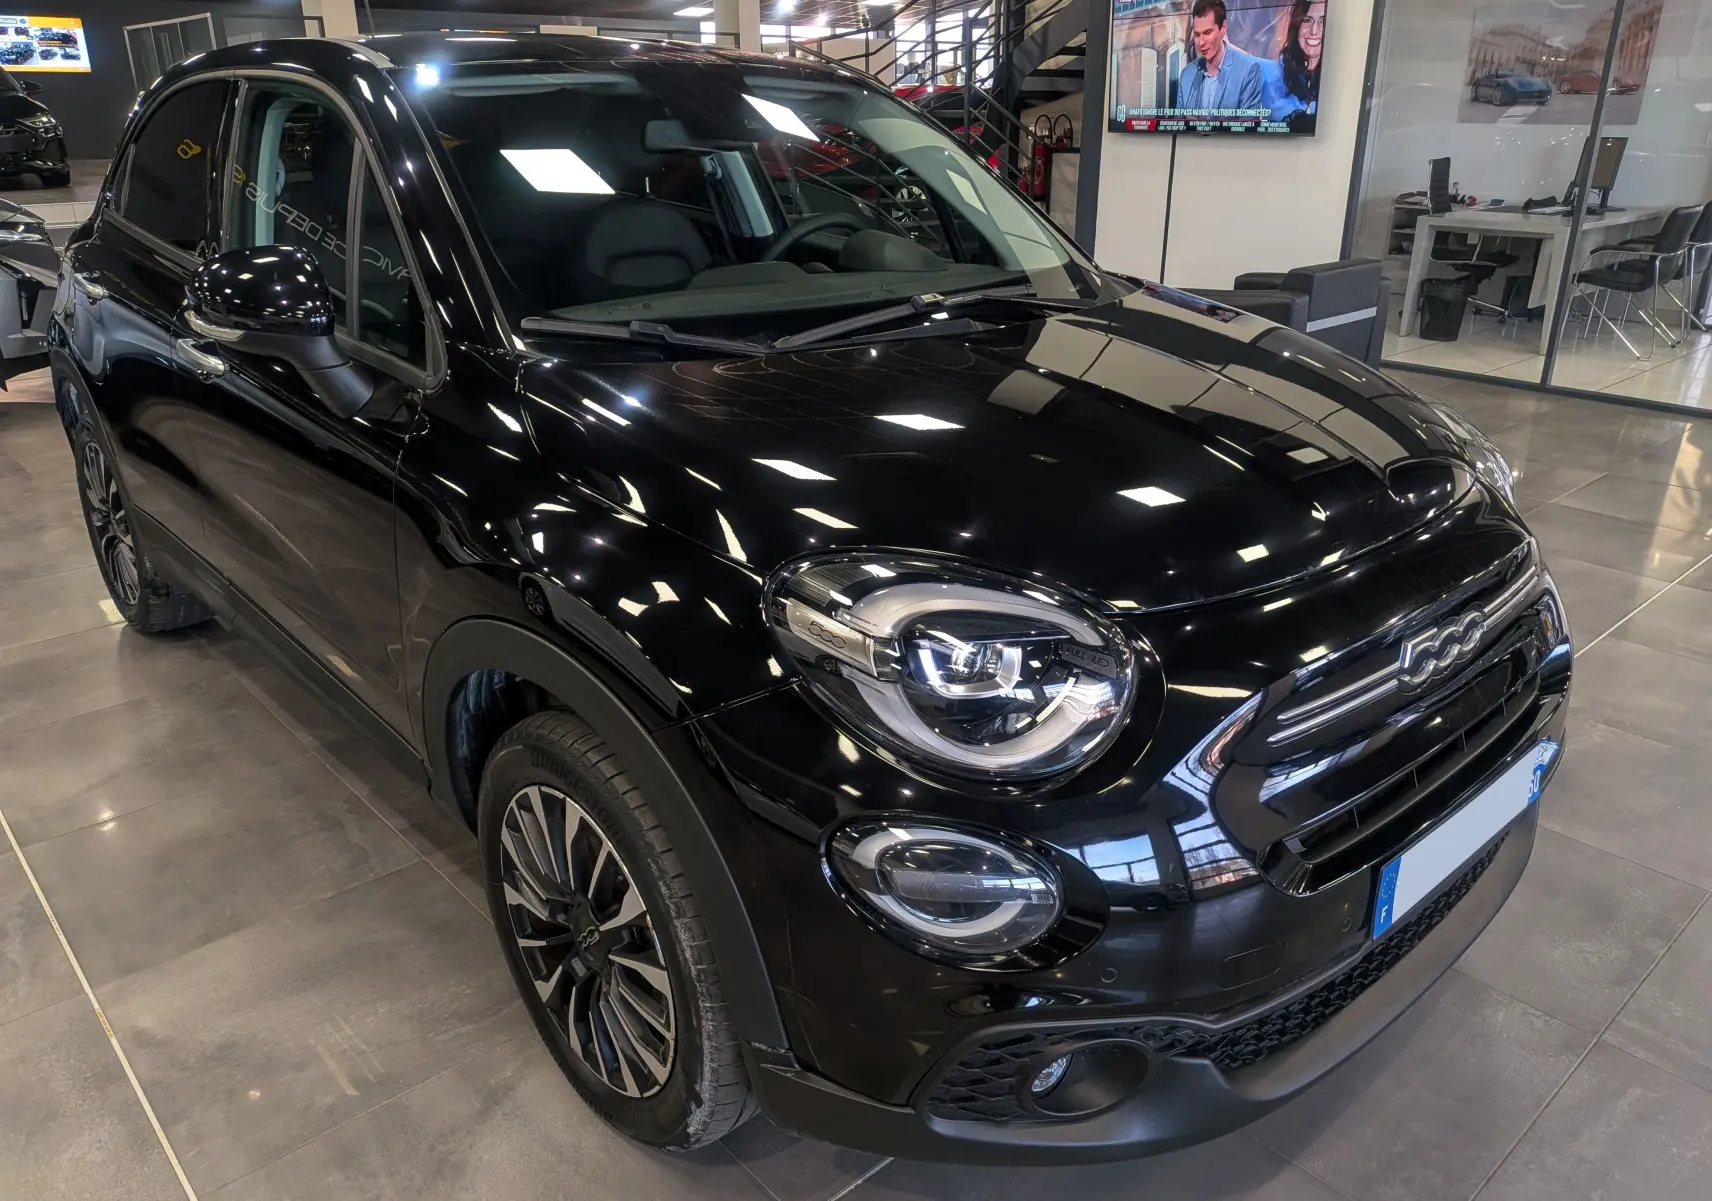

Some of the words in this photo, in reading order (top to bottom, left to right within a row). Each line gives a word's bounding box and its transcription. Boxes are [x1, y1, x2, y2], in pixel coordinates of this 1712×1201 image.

[1158, 108, 1164, 116] LE
[1164, 108, 1174, 116] PRIX
[1181, 108, 1192, 116] PASS
[1211, 108, 1236, 117] POLITIQUES
[808, 620, 847, 649] 500
[1066, 647, 1085, 660] FULL
[1092, 654, 1110, 668] LED
[1379, 905, 1388, 924] F
